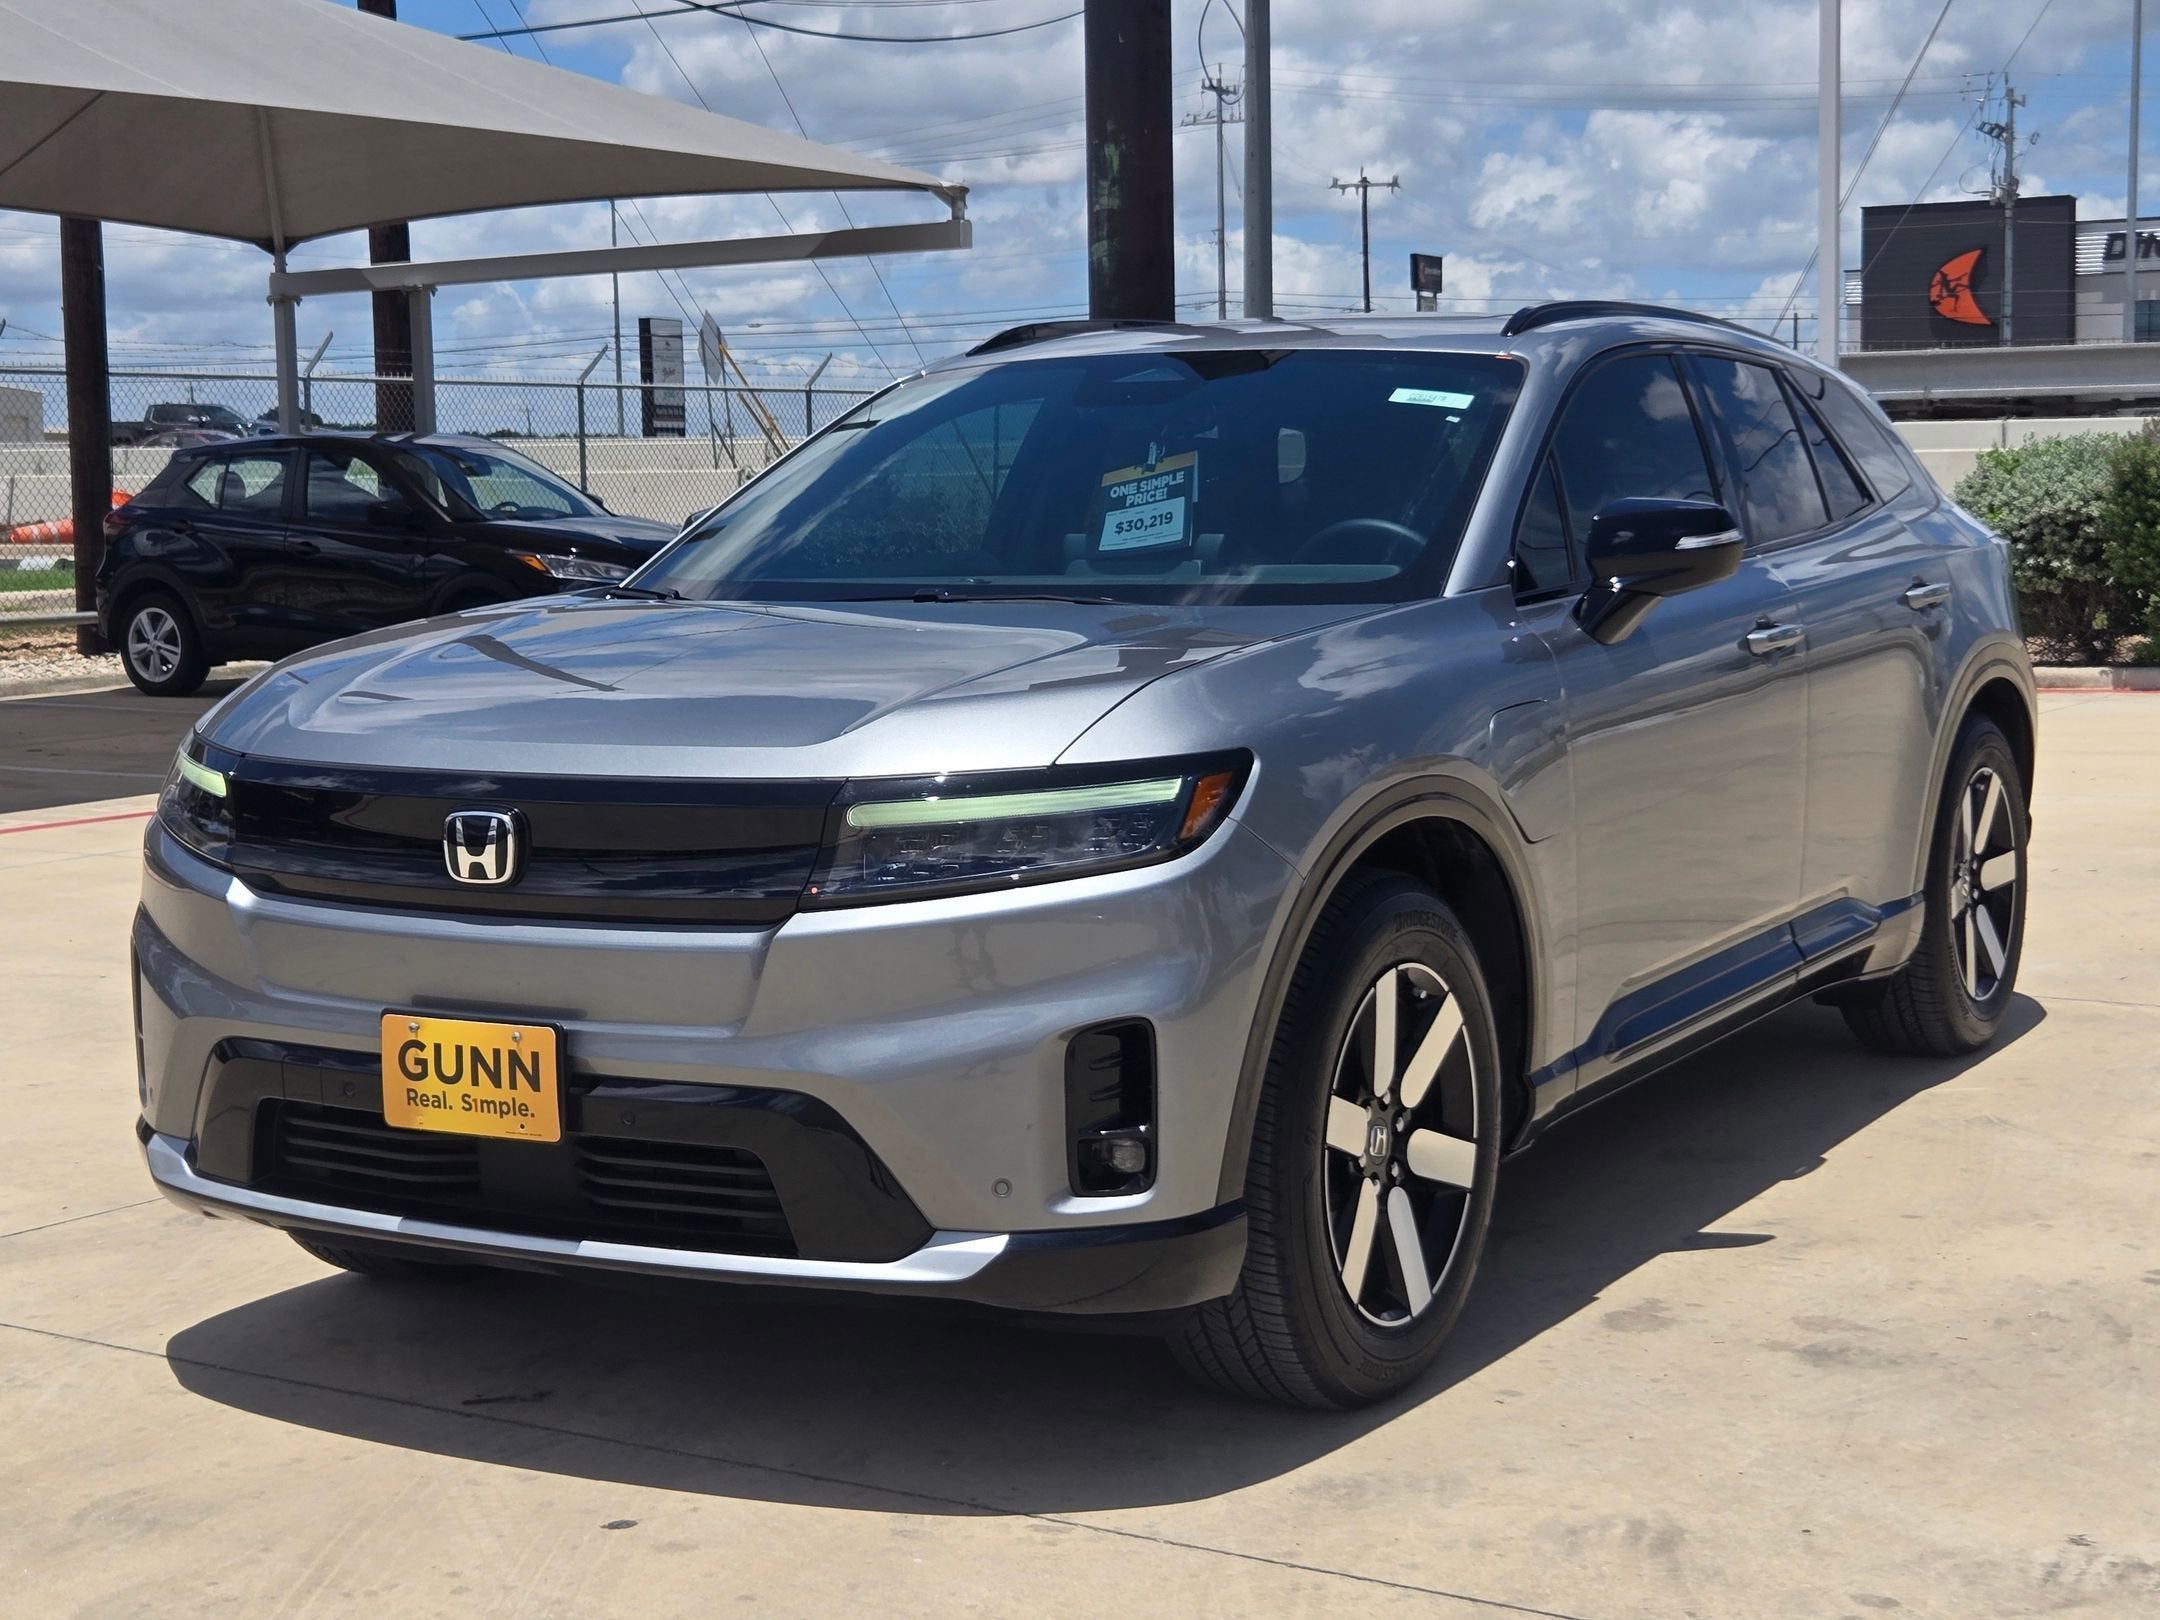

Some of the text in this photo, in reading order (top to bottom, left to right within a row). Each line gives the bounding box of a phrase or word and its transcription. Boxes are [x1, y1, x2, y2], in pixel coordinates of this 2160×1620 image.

[1110, 471, 1185, 498] ONE SIMPLE
[1126, 487, 1168, 507] PRICE!
[1114, 511, 1174, 535] $30,219
[455, 816, 498, 879] H
[398, 1039, 541, 1093] GUNN
[406, 1087, 453, 1110] Real.
